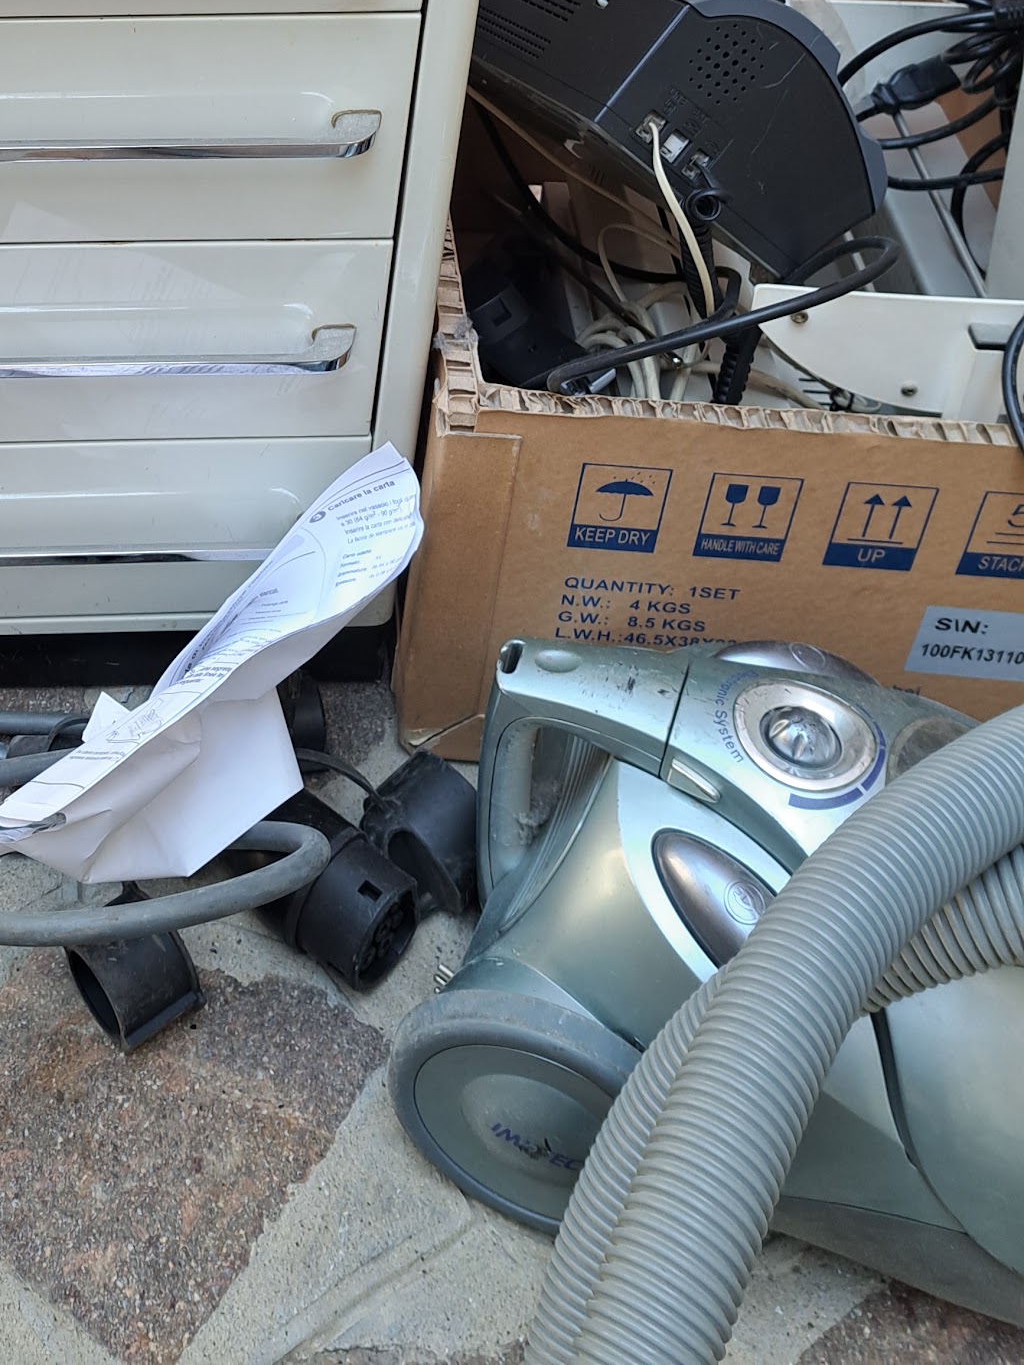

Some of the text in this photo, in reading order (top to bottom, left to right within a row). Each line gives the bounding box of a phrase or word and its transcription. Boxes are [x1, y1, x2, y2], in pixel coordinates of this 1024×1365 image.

[574, 527, 651, 546] KEEP DRY
[700, 538, 780, 555] HANDLE WITH CARE
[857, 548, 885, 564] UP
[564, 577, 741, 600] QUANTITY: 1SET
[561, 594, 691, 614] N.W.: 4 KGS
[558, 611, 706, 632] G.W.: 8.5 KGS
[713, 710, 744, 763] System
